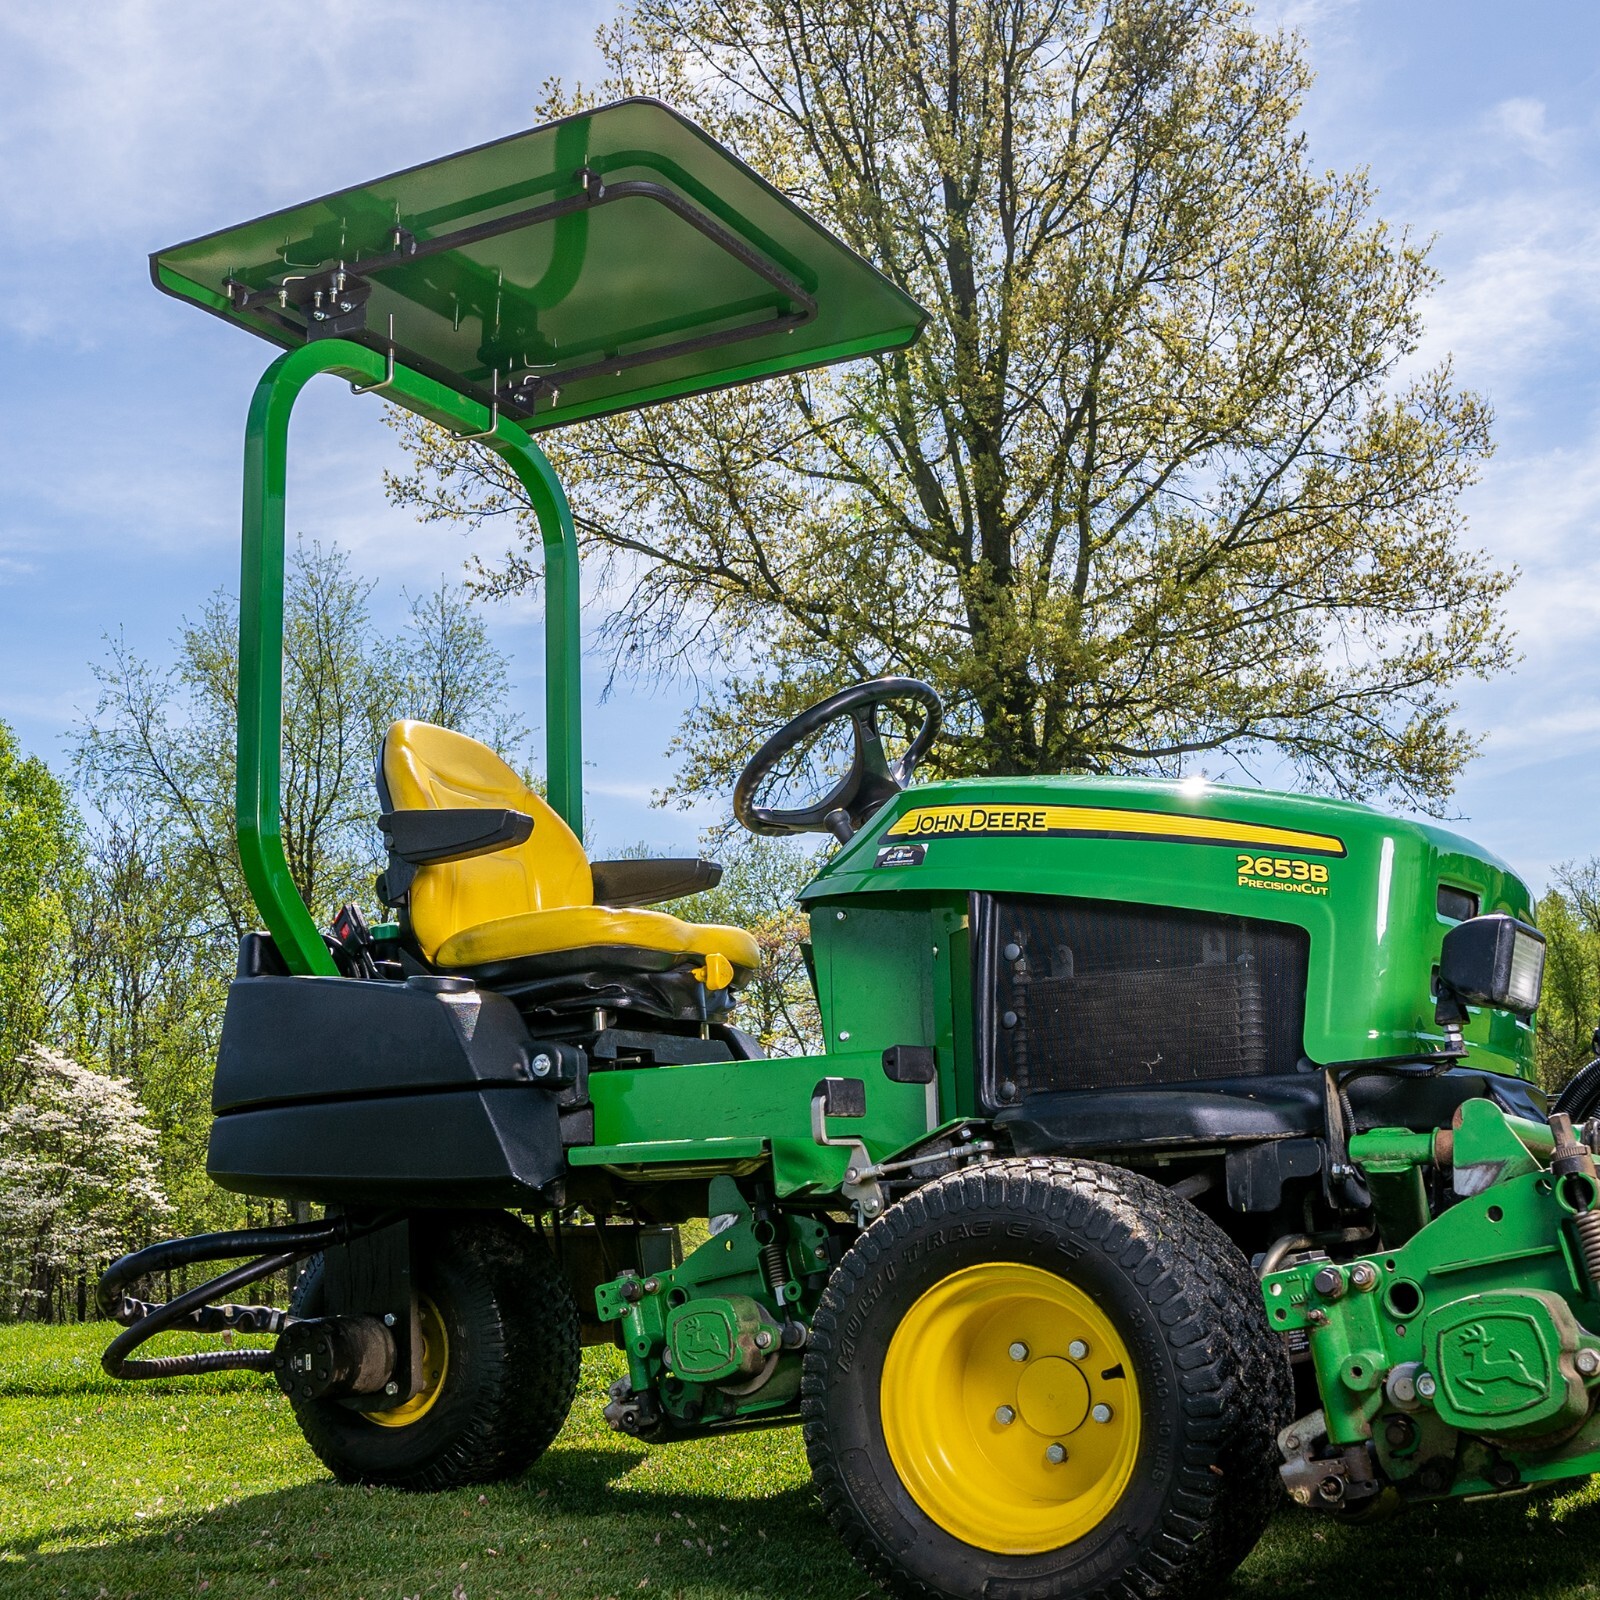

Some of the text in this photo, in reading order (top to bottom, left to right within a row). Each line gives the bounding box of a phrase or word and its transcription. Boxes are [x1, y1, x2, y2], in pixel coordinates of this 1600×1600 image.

[908, 809, 1046, 833] JOHN DEERE
[1237, 855, 1329, 883] 2653B
[837, 1262, 897, 1373] MULTI
